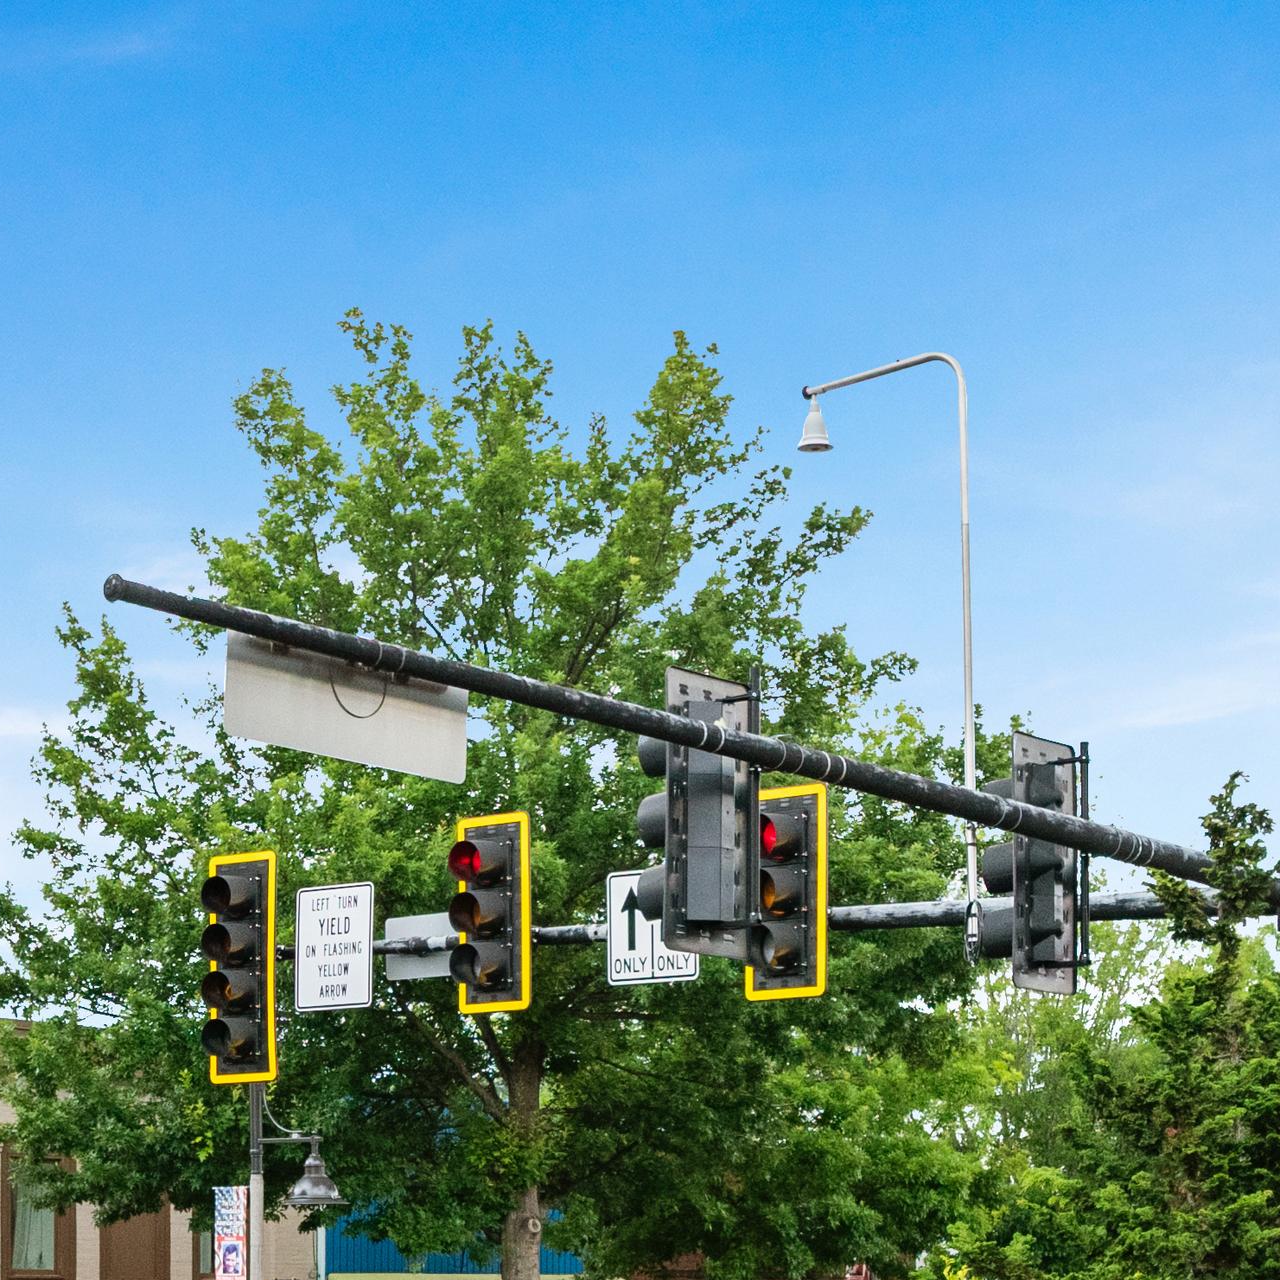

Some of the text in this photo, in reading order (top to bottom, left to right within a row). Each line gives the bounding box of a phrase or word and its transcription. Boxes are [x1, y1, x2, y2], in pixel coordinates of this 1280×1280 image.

[311, 895, 359, 912] LEFT TURN
[319, 916, 350, 936] YIELD
[305, 941, 362, 958] ON FLASHING
[318, 963, 349, 978] YELLOW
[614, 956, 647, 974] ONLY
[657, 953, 691, 971] ONLY
[319, 984, 348, 999] ARROW
